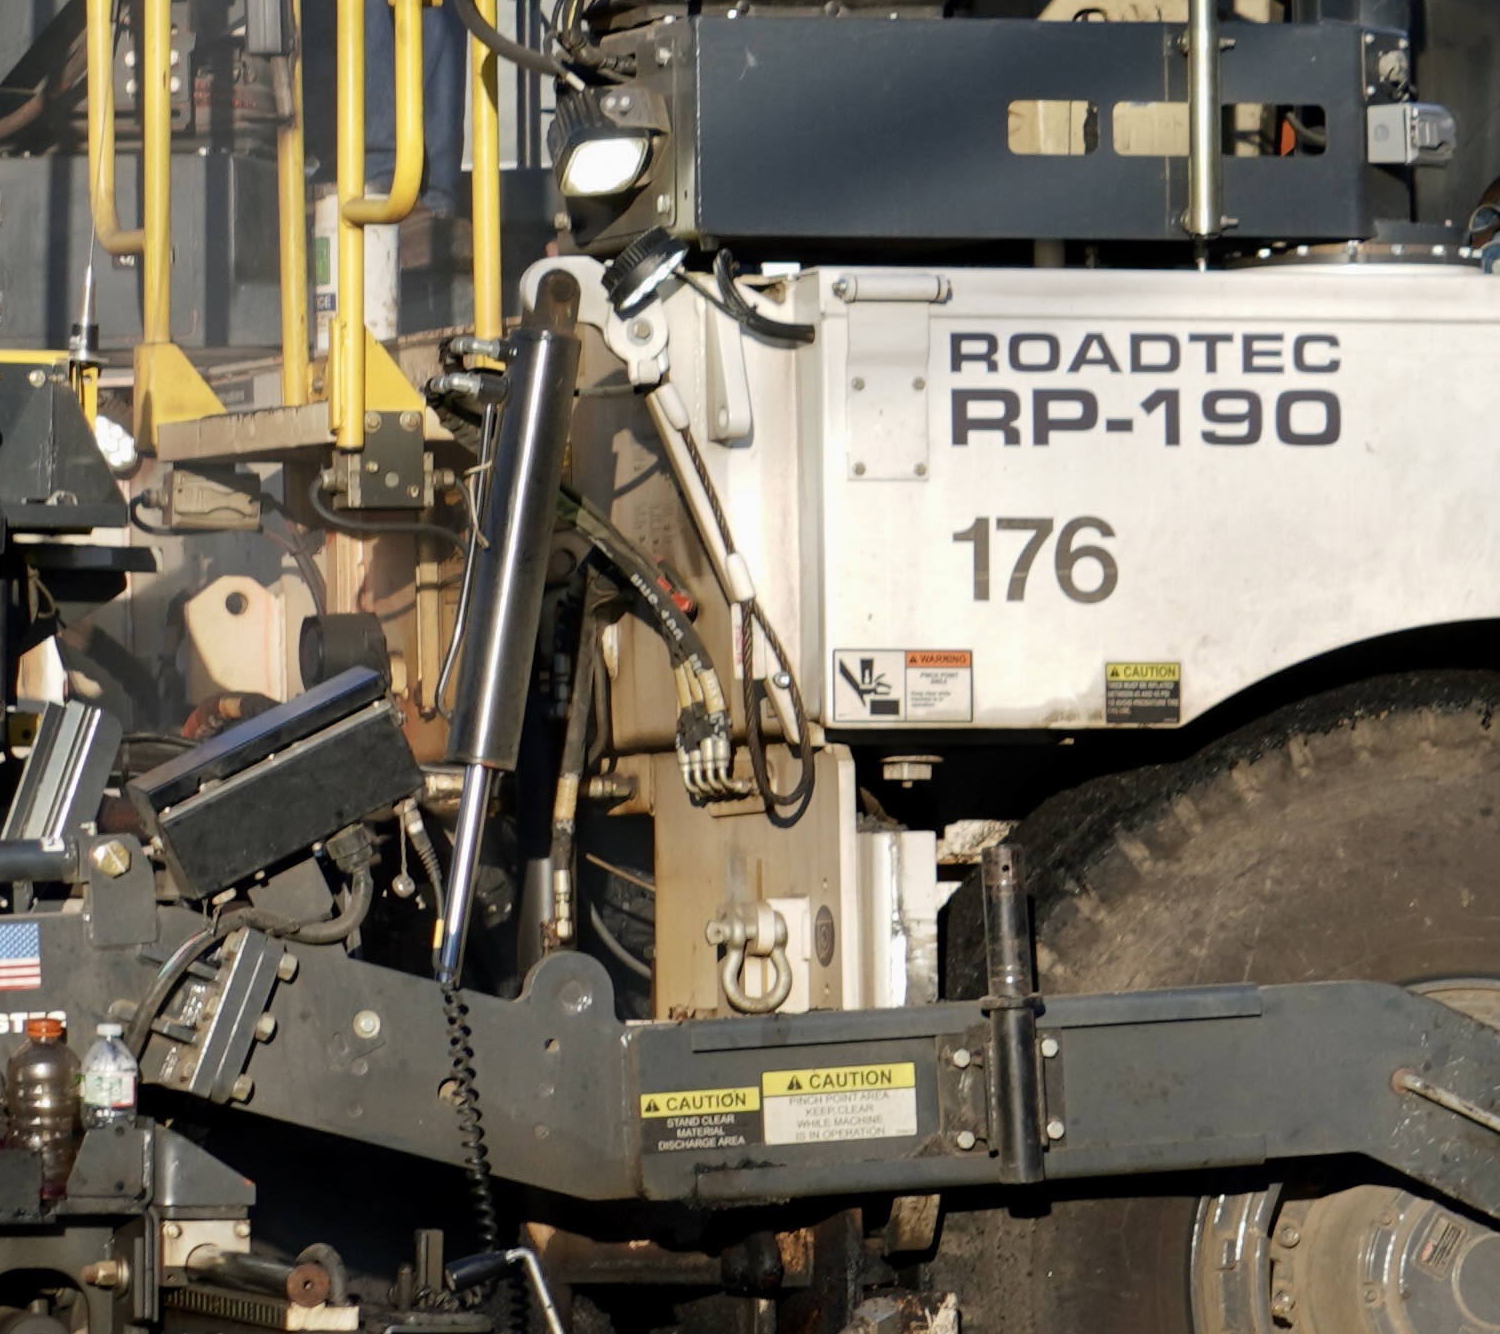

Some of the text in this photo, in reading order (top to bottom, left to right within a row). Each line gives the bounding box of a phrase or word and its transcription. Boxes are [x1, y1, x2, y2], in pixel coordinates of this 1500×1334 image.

[950, 332, 1341, 374] ROADTEC
[951, 388, 1342, 446] RP-190
[952, 515, 1119, 604] 176
[920, 655, 967, 664] WARNING
[1123, 666, 1176, 678] CAUTION
[808, 1069, 893, 1089] CAUTION
[666, 1092, 747, 1111] CAUTION
[789, 1091, 890, 1106] PINCH POINT AREA
[837, 1104, 874, 1114] CLEAR
[666, 1113, 736, 1129] STAND CLEAR
[796, 1114, 884, 1129] WHILE MACHINE
[676, 1126, 726, 1139] MATERIAL
[796, 1131, 806, 1141] IS
[809, 1130, 820, 1140] IN
[823, 1127, 886, 1139] OPERATION
[657, 1134, 746, 1152] DISCHARGE AREA
